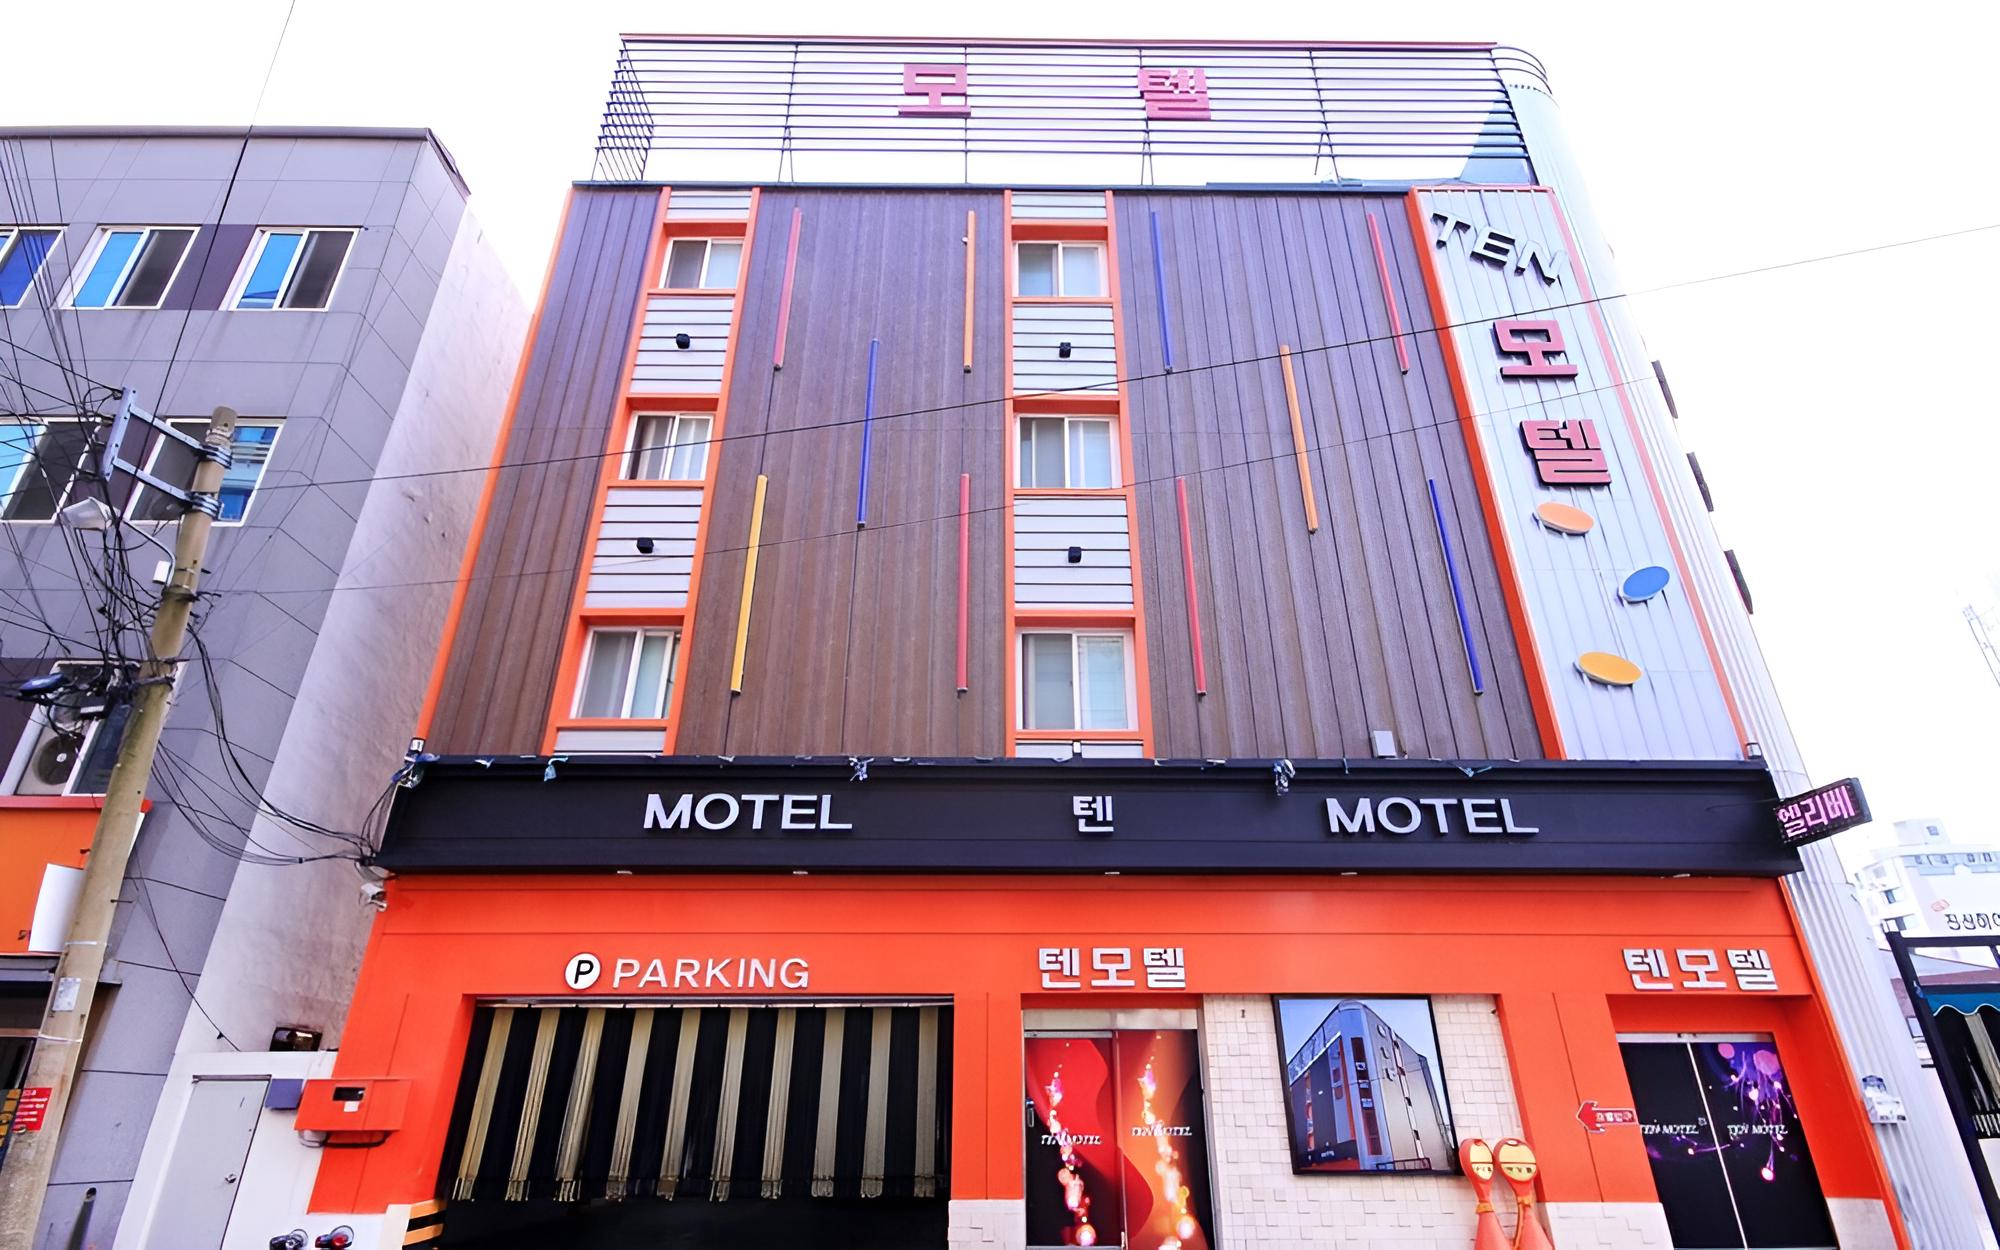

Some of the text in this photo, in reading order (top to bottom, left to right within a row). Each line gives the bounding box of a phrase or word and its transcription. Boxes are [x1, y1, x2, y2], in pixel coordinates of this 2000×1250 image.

[1431, 210, 1567, 286] TEN
[643, 793, 1541, 836] MOTEL 텐 MOTEL
[612, 957, 810, 989] PARKING
[1038, 946, 1187, 990] 텐모텔
[1623, 948, 1779, 992] 텐모텔
